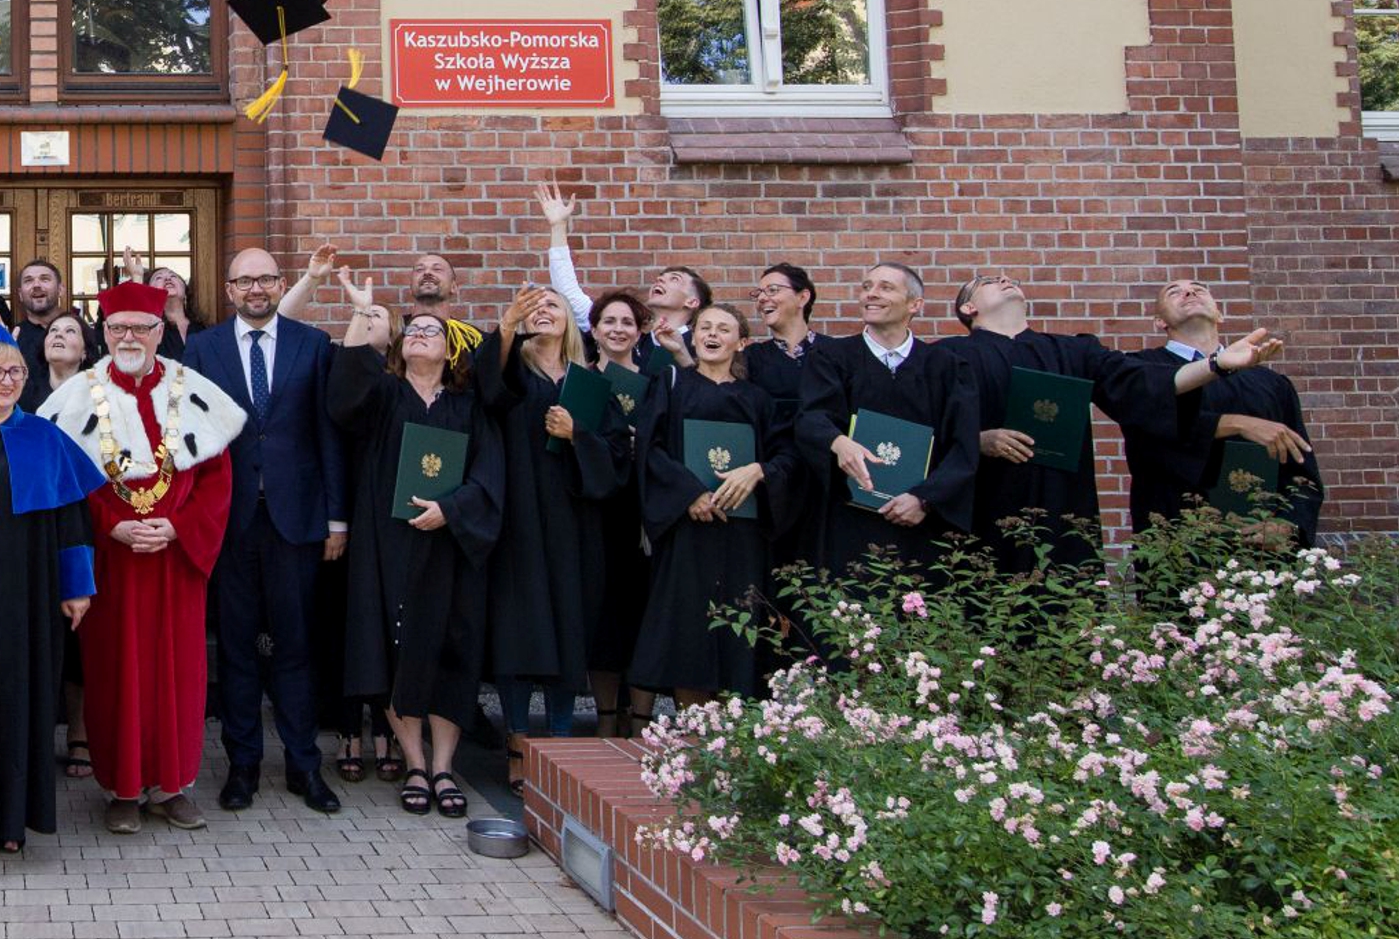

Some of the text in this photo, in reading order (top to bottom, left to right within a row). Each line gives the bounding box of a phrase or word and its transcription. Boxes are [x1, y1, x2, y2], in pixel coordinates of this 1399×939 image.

[404, 31, 599, 48] Kaszubsko-Pomorska
[434, 53, 571, 73] Szkoła Wyższa
[435, 75, 572, 94] w Wejherowie
